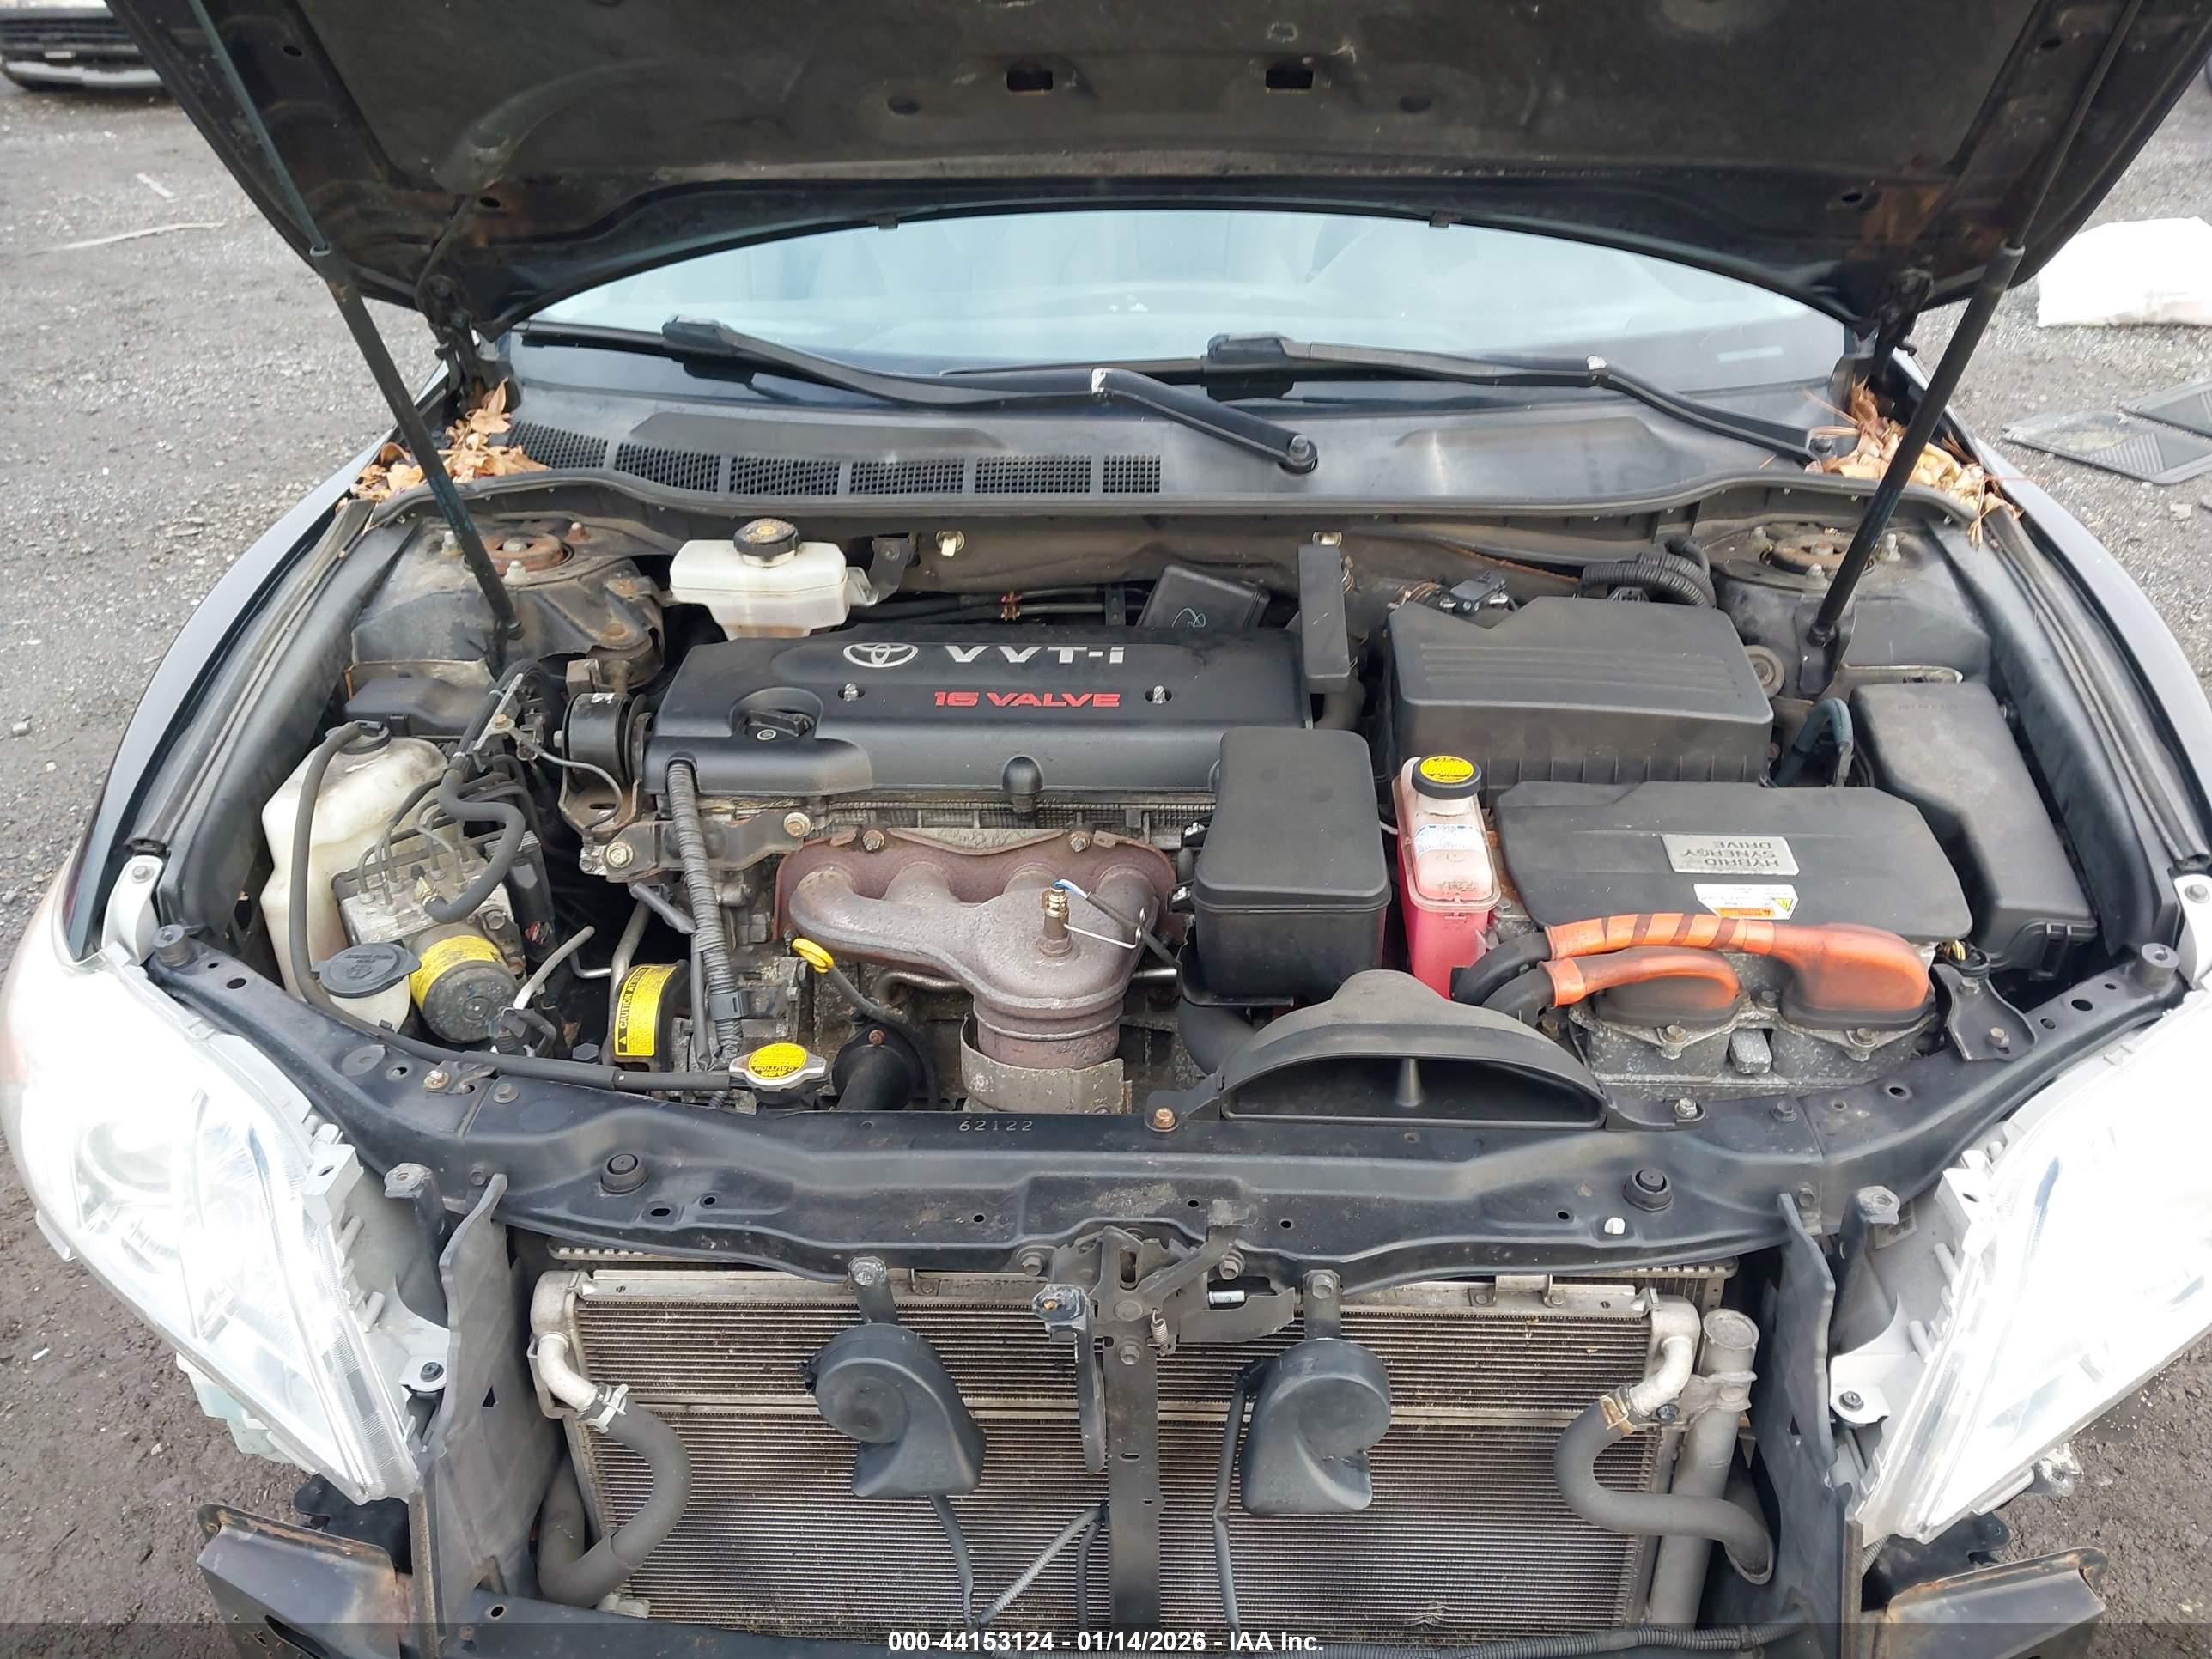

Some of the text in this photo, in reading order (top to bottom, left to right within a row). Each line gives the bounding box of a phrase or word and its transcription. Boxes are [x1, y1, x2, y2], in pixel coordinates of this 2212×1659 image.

[944, 644, 1126, 665] VVT-i
[934, 690, 1121, 708] 16 VALVE
[1713, 841, 1771, 849] DRIVE
[1683, 849, 1777, 858] SYNERGY
[1705, 859, 1779, 867] HYBRID
[620, 994, 633, 1030] CAUTION
[958, 1120, 1034, 1132] 62122
